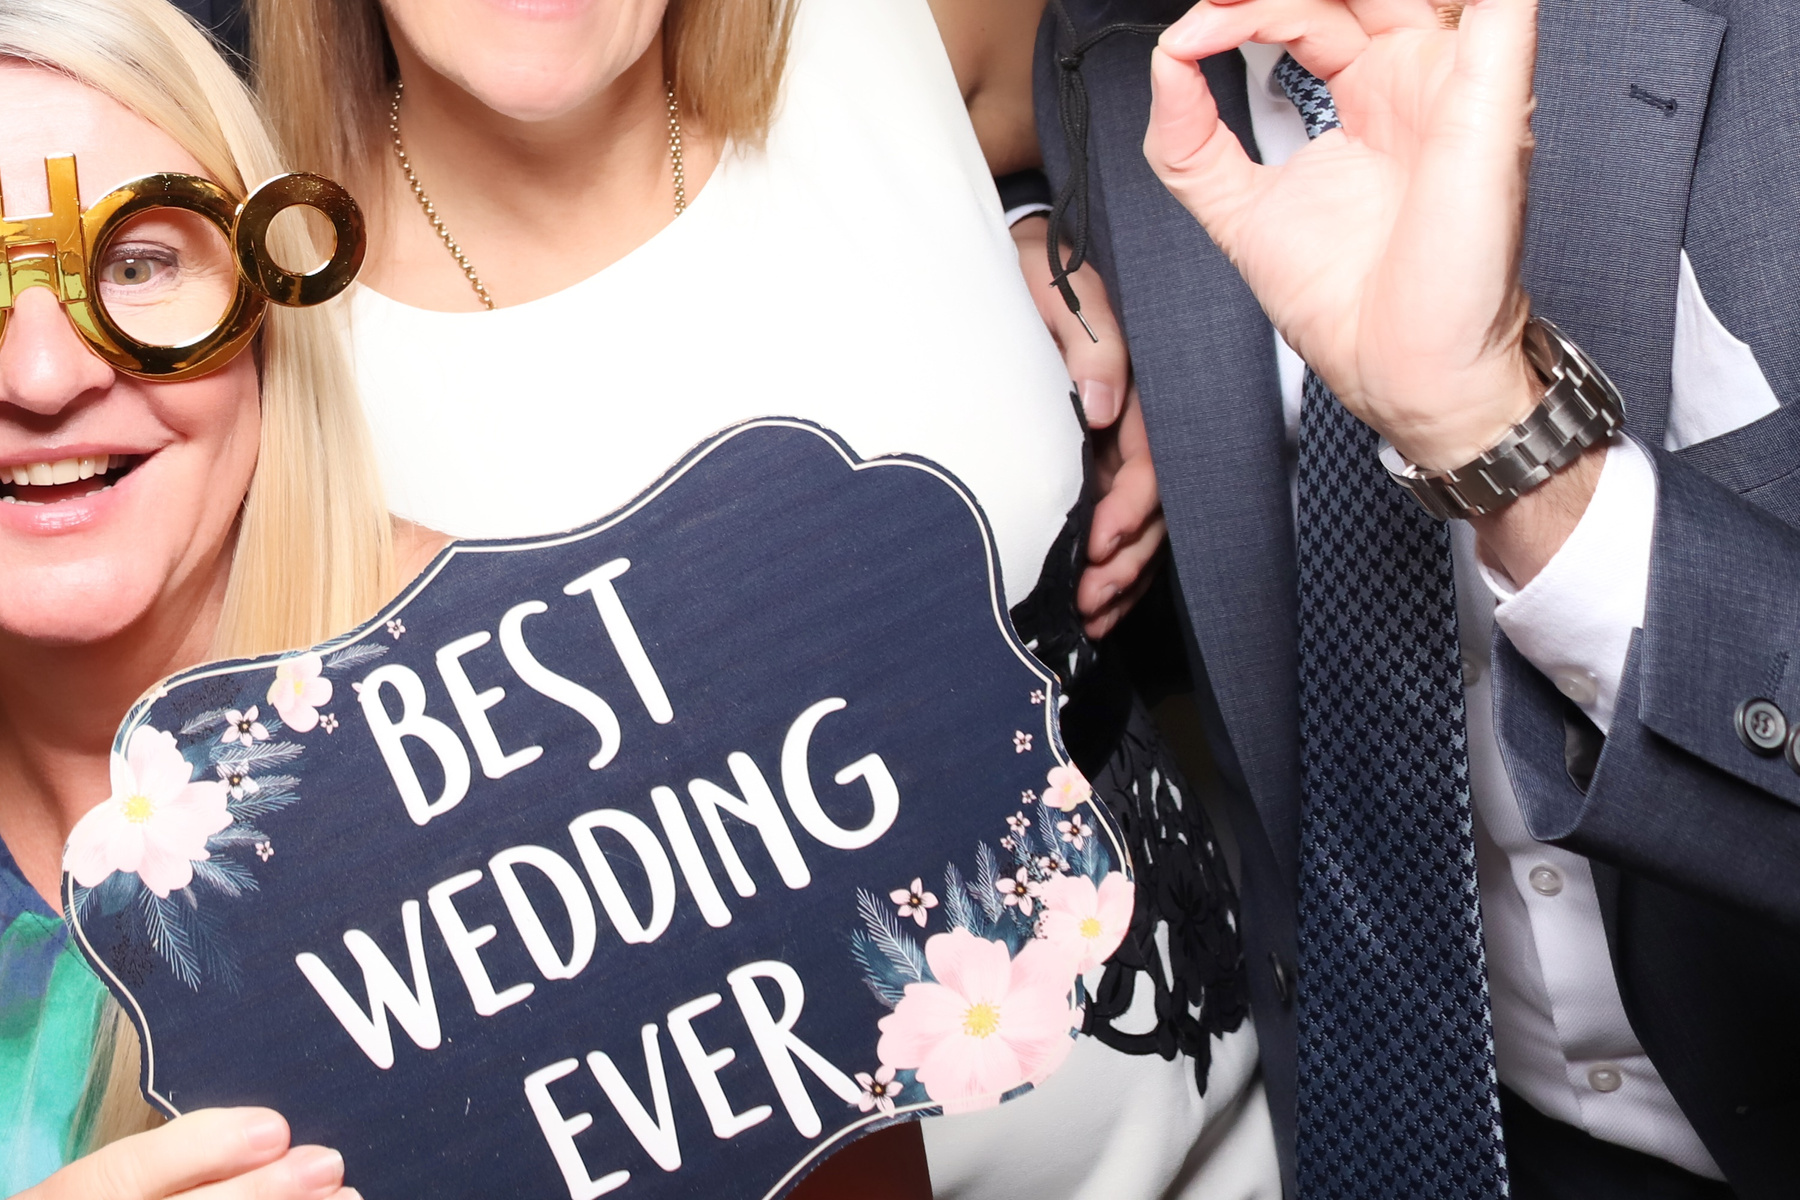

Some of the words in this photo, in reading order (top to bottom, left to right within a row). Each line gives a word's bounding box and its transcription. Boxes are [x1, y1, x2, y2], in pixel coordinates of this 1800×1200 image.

[357, 557, 675, 826] BEST
[295, 696, 901, 1070] WEDDING
[524, 959, 864, 1200] EVER
